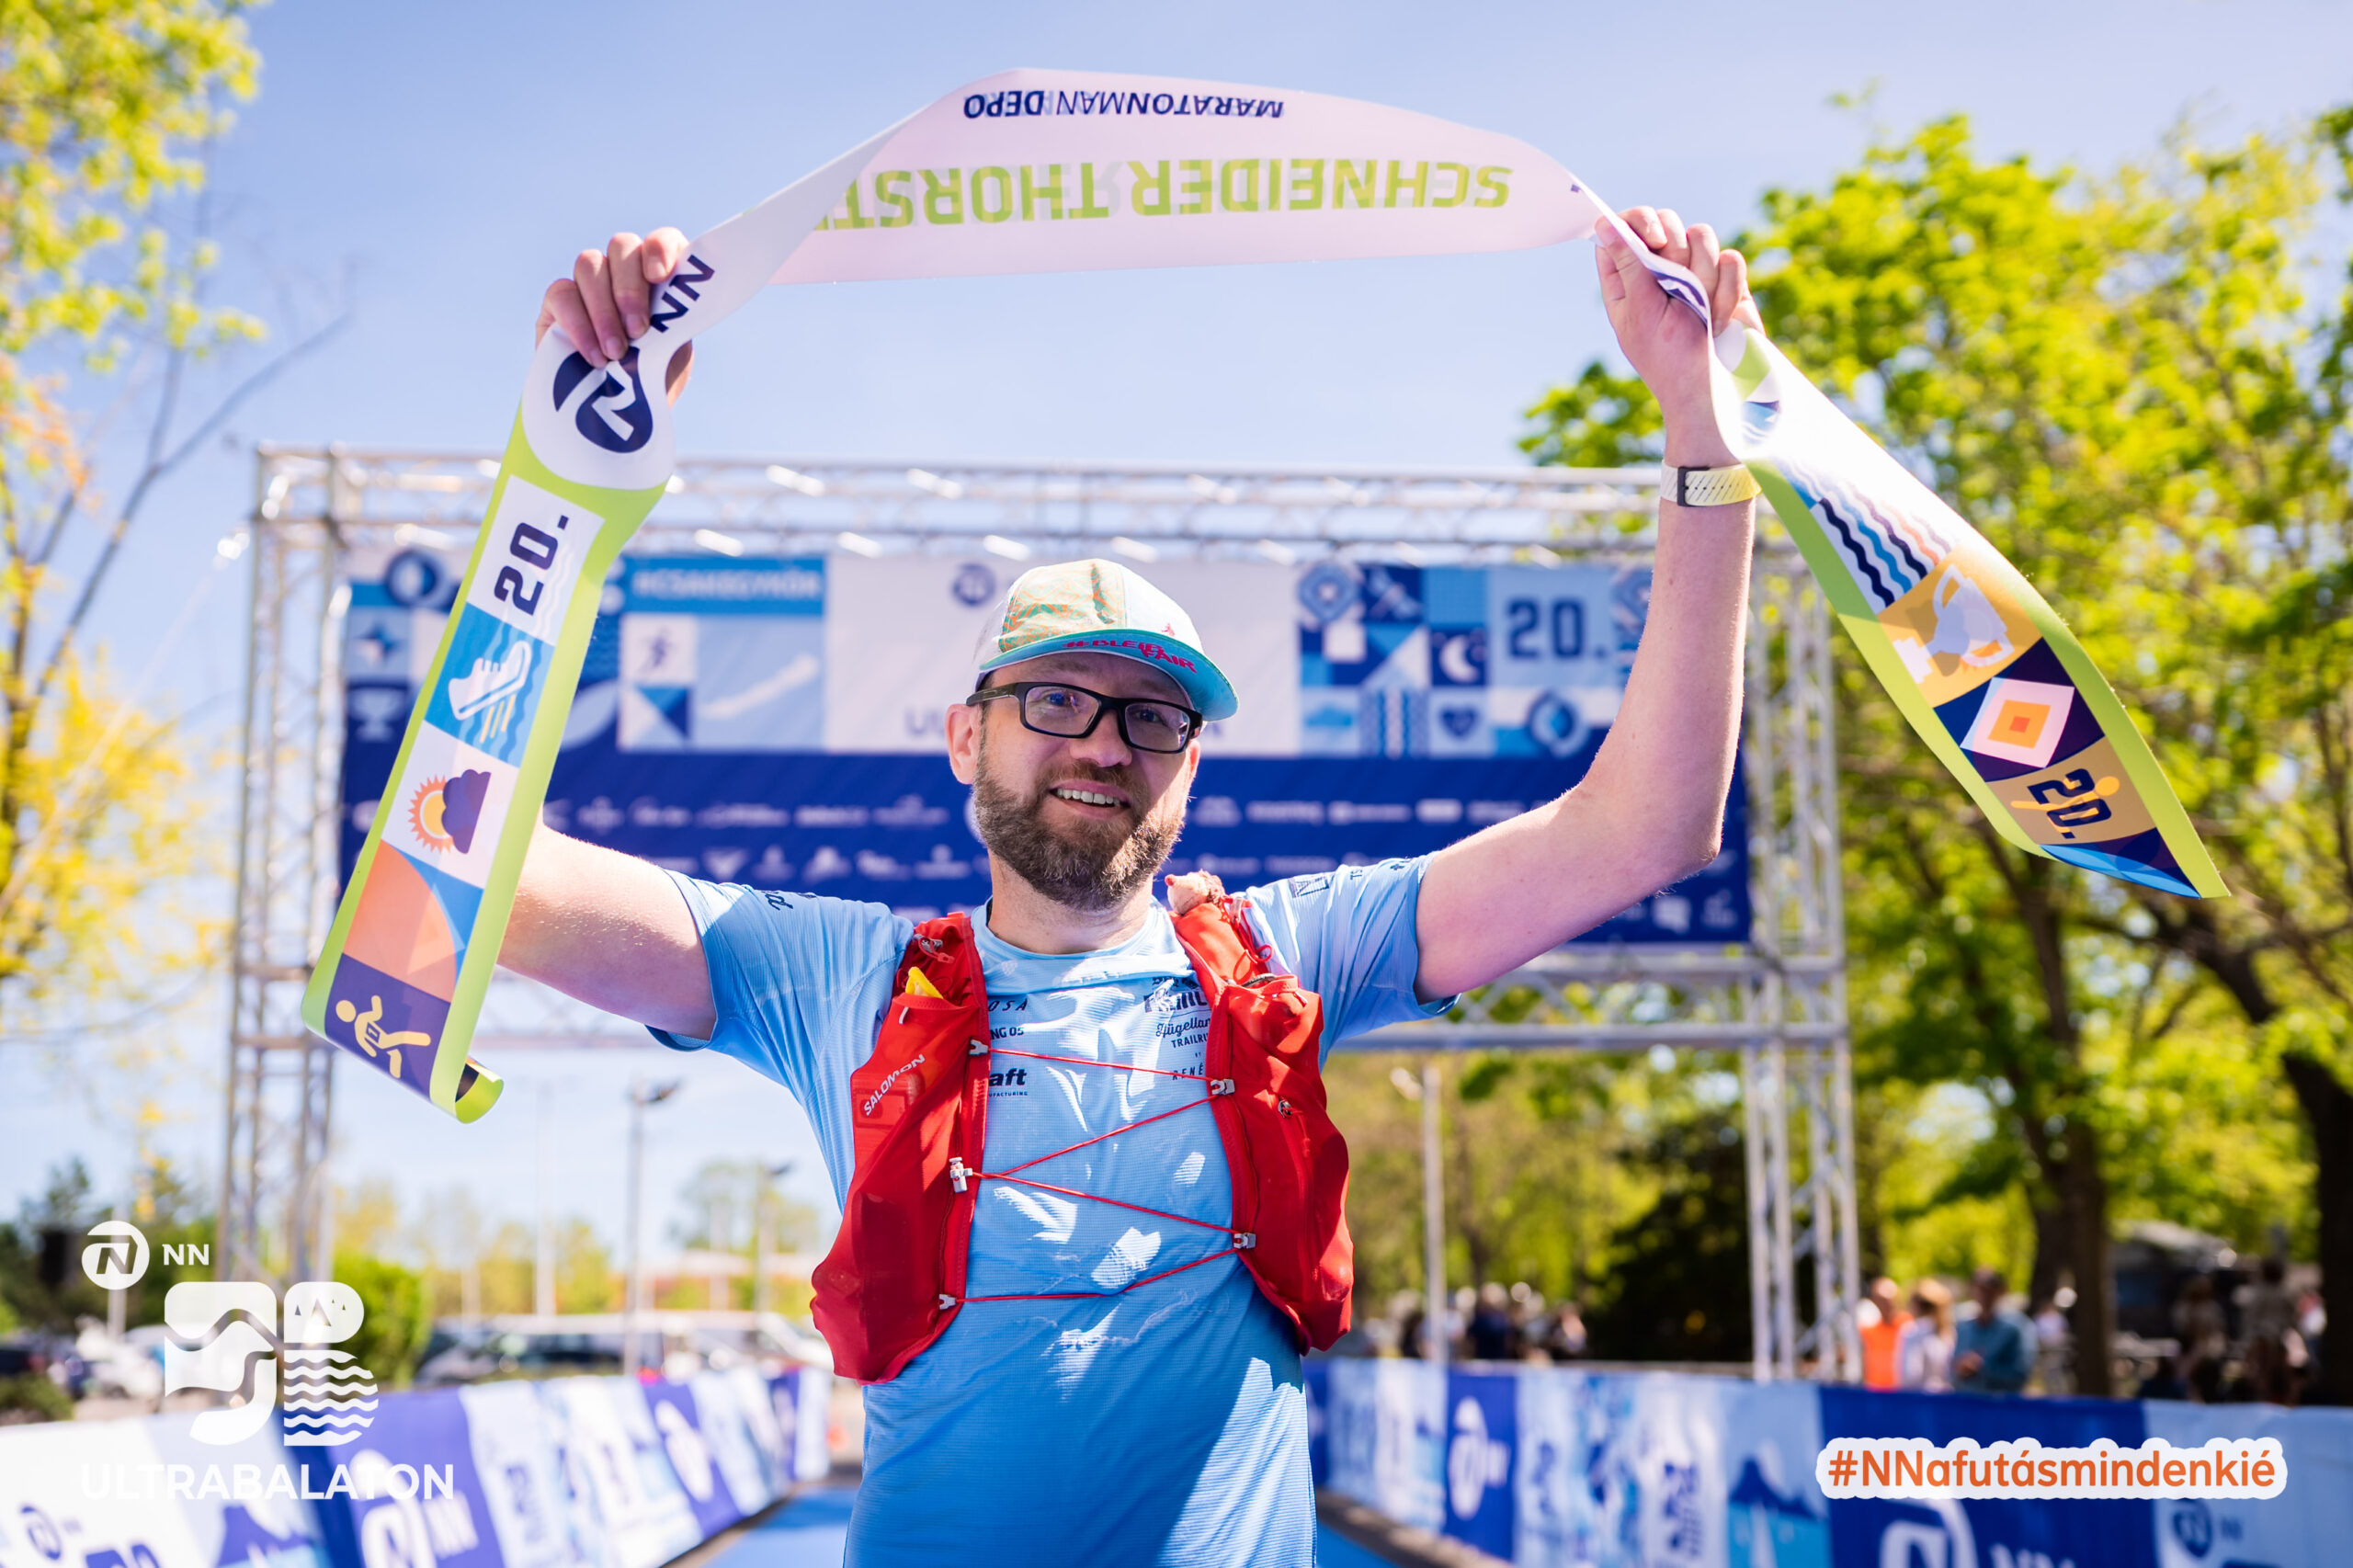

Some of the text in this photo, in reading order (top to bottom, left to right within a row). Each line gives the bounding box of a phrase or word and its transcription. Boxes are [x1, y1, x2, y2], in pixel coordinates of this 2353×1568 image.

[964, 90, 1284, 119] MARATONMAN DEPO
[813, 159, 1514, 231] SCHNEIDER THORST
[650, 255, 715, 333] NN
[864, 1054, 926, 1117] SALOMON
